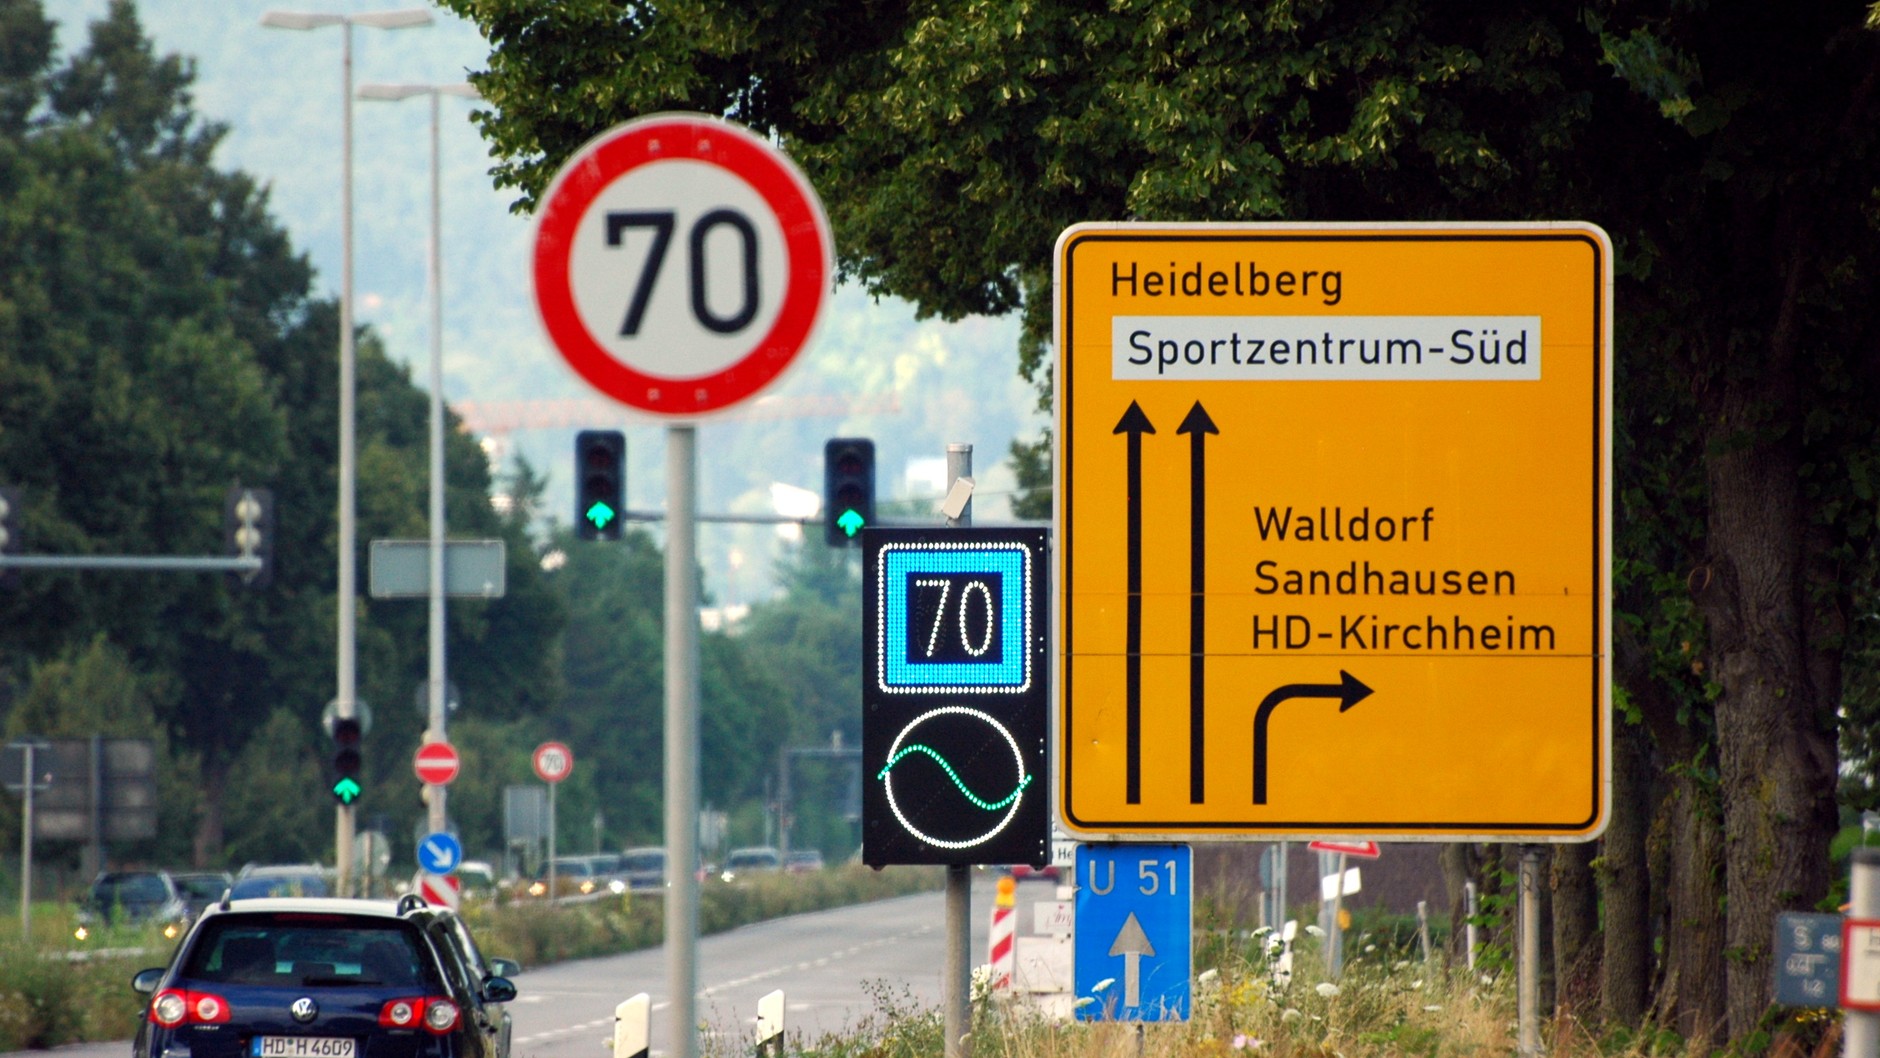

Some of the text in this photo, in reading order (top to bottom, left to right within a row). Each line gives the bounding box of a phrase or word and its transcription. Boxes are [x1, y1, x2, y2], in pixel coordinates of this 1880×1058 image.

[605, 206, 762, 339] 70
[1111, 261, 1343, 306] Heidelberg
[1128, 328, 1528, 375] Sportzentrum-Süd
[1253, 506, 1435, 542] Walldorf
[1254, 560, 1516, 596] Sandhausen
[914, 579, 995, 658] 70
[1252, 614, 1556, 651] HD-Kirchheim
[1088, 859, 1179, 896] U 51
[263, 1038, 354, 1057] HD H 4609
